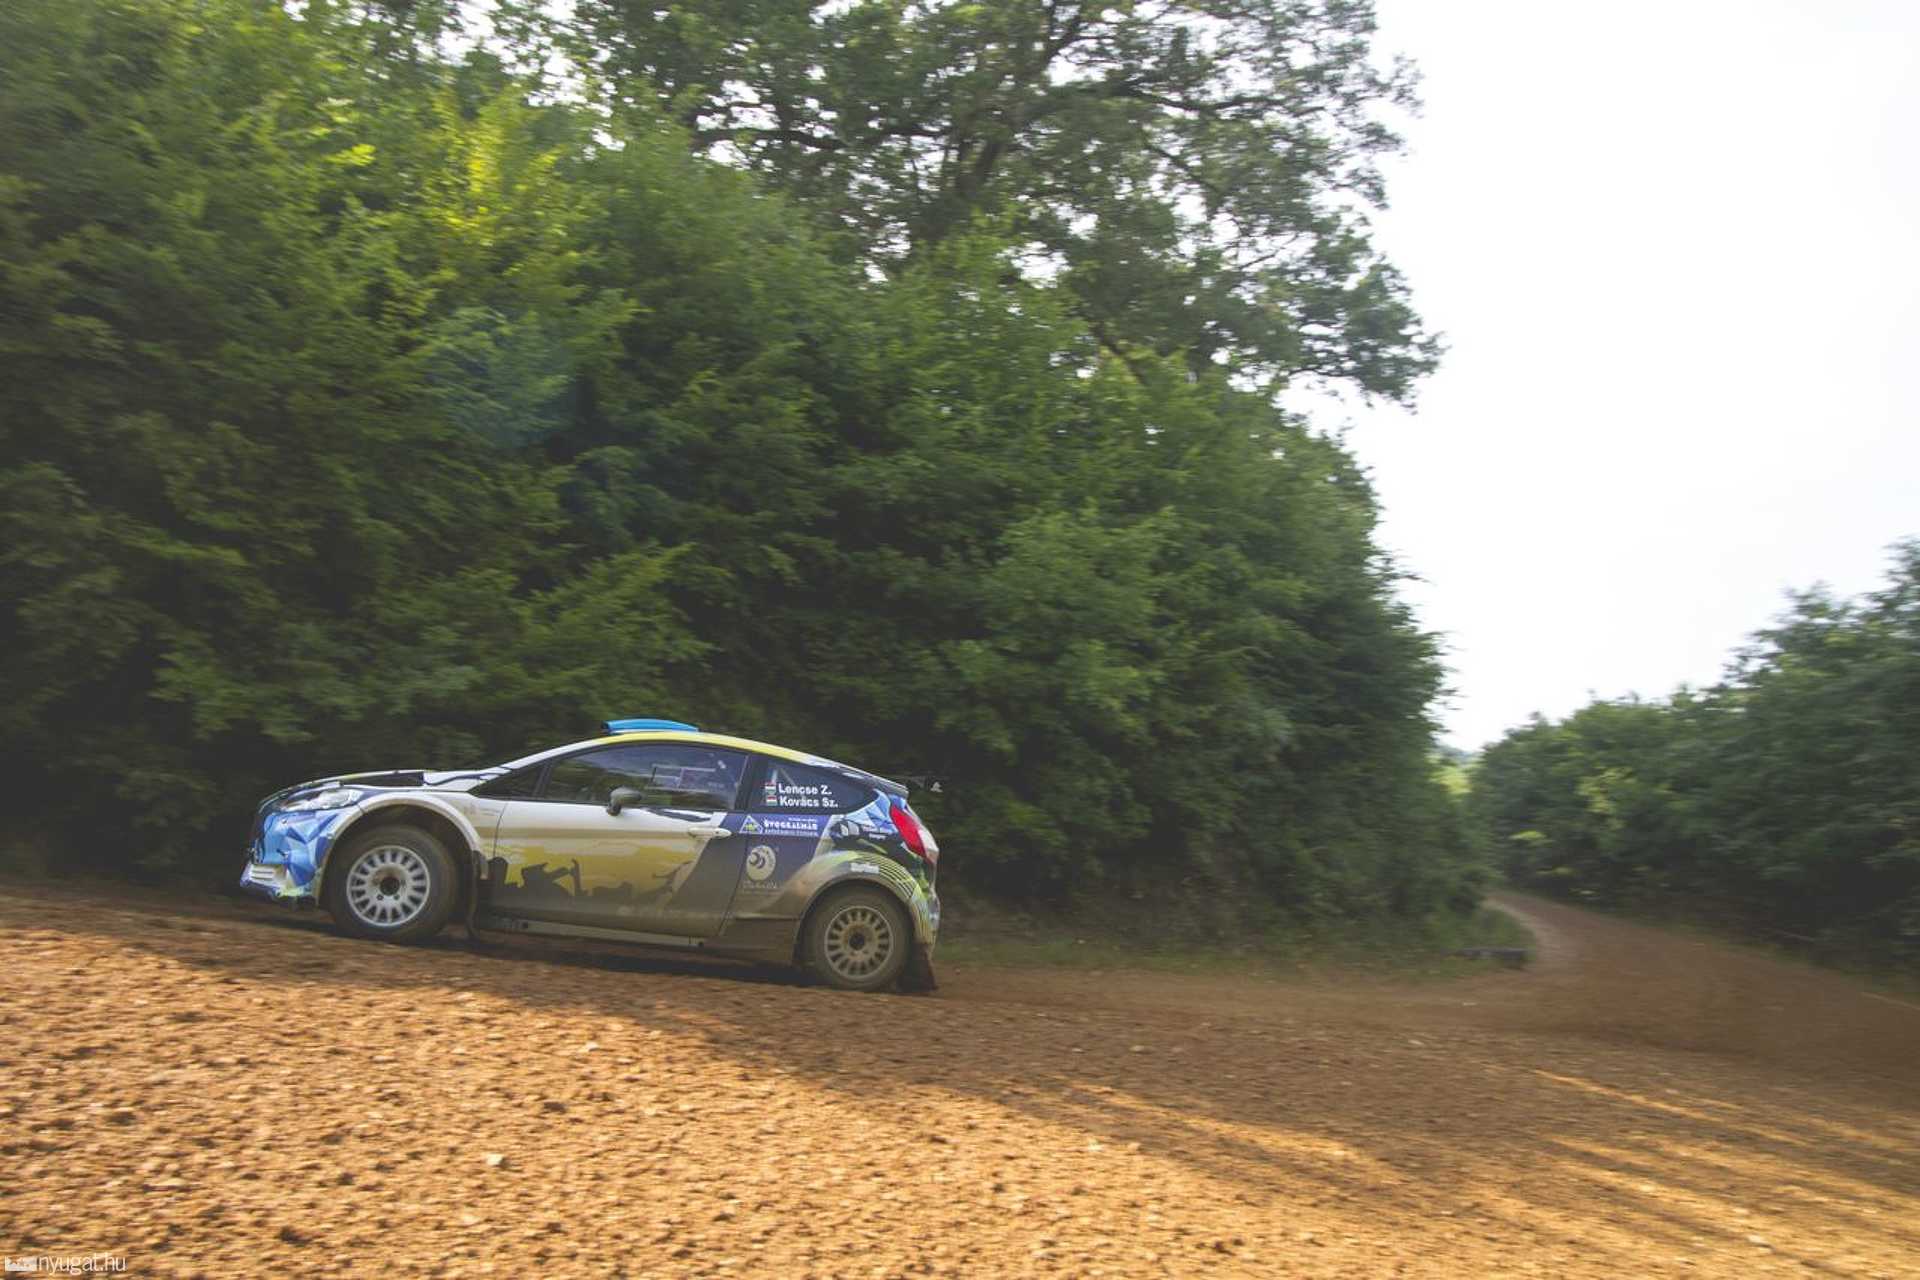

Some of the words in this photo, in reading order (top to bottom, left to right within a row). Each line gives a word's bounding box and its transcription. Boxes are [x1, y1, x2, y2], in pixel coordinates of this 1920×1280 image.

[778, 783, 818, 795] Lencse
[820, 784, 833, 795] Z.
[779, 795, 819, 807] Kovács
[822, 797, 838, 808] Sz.
